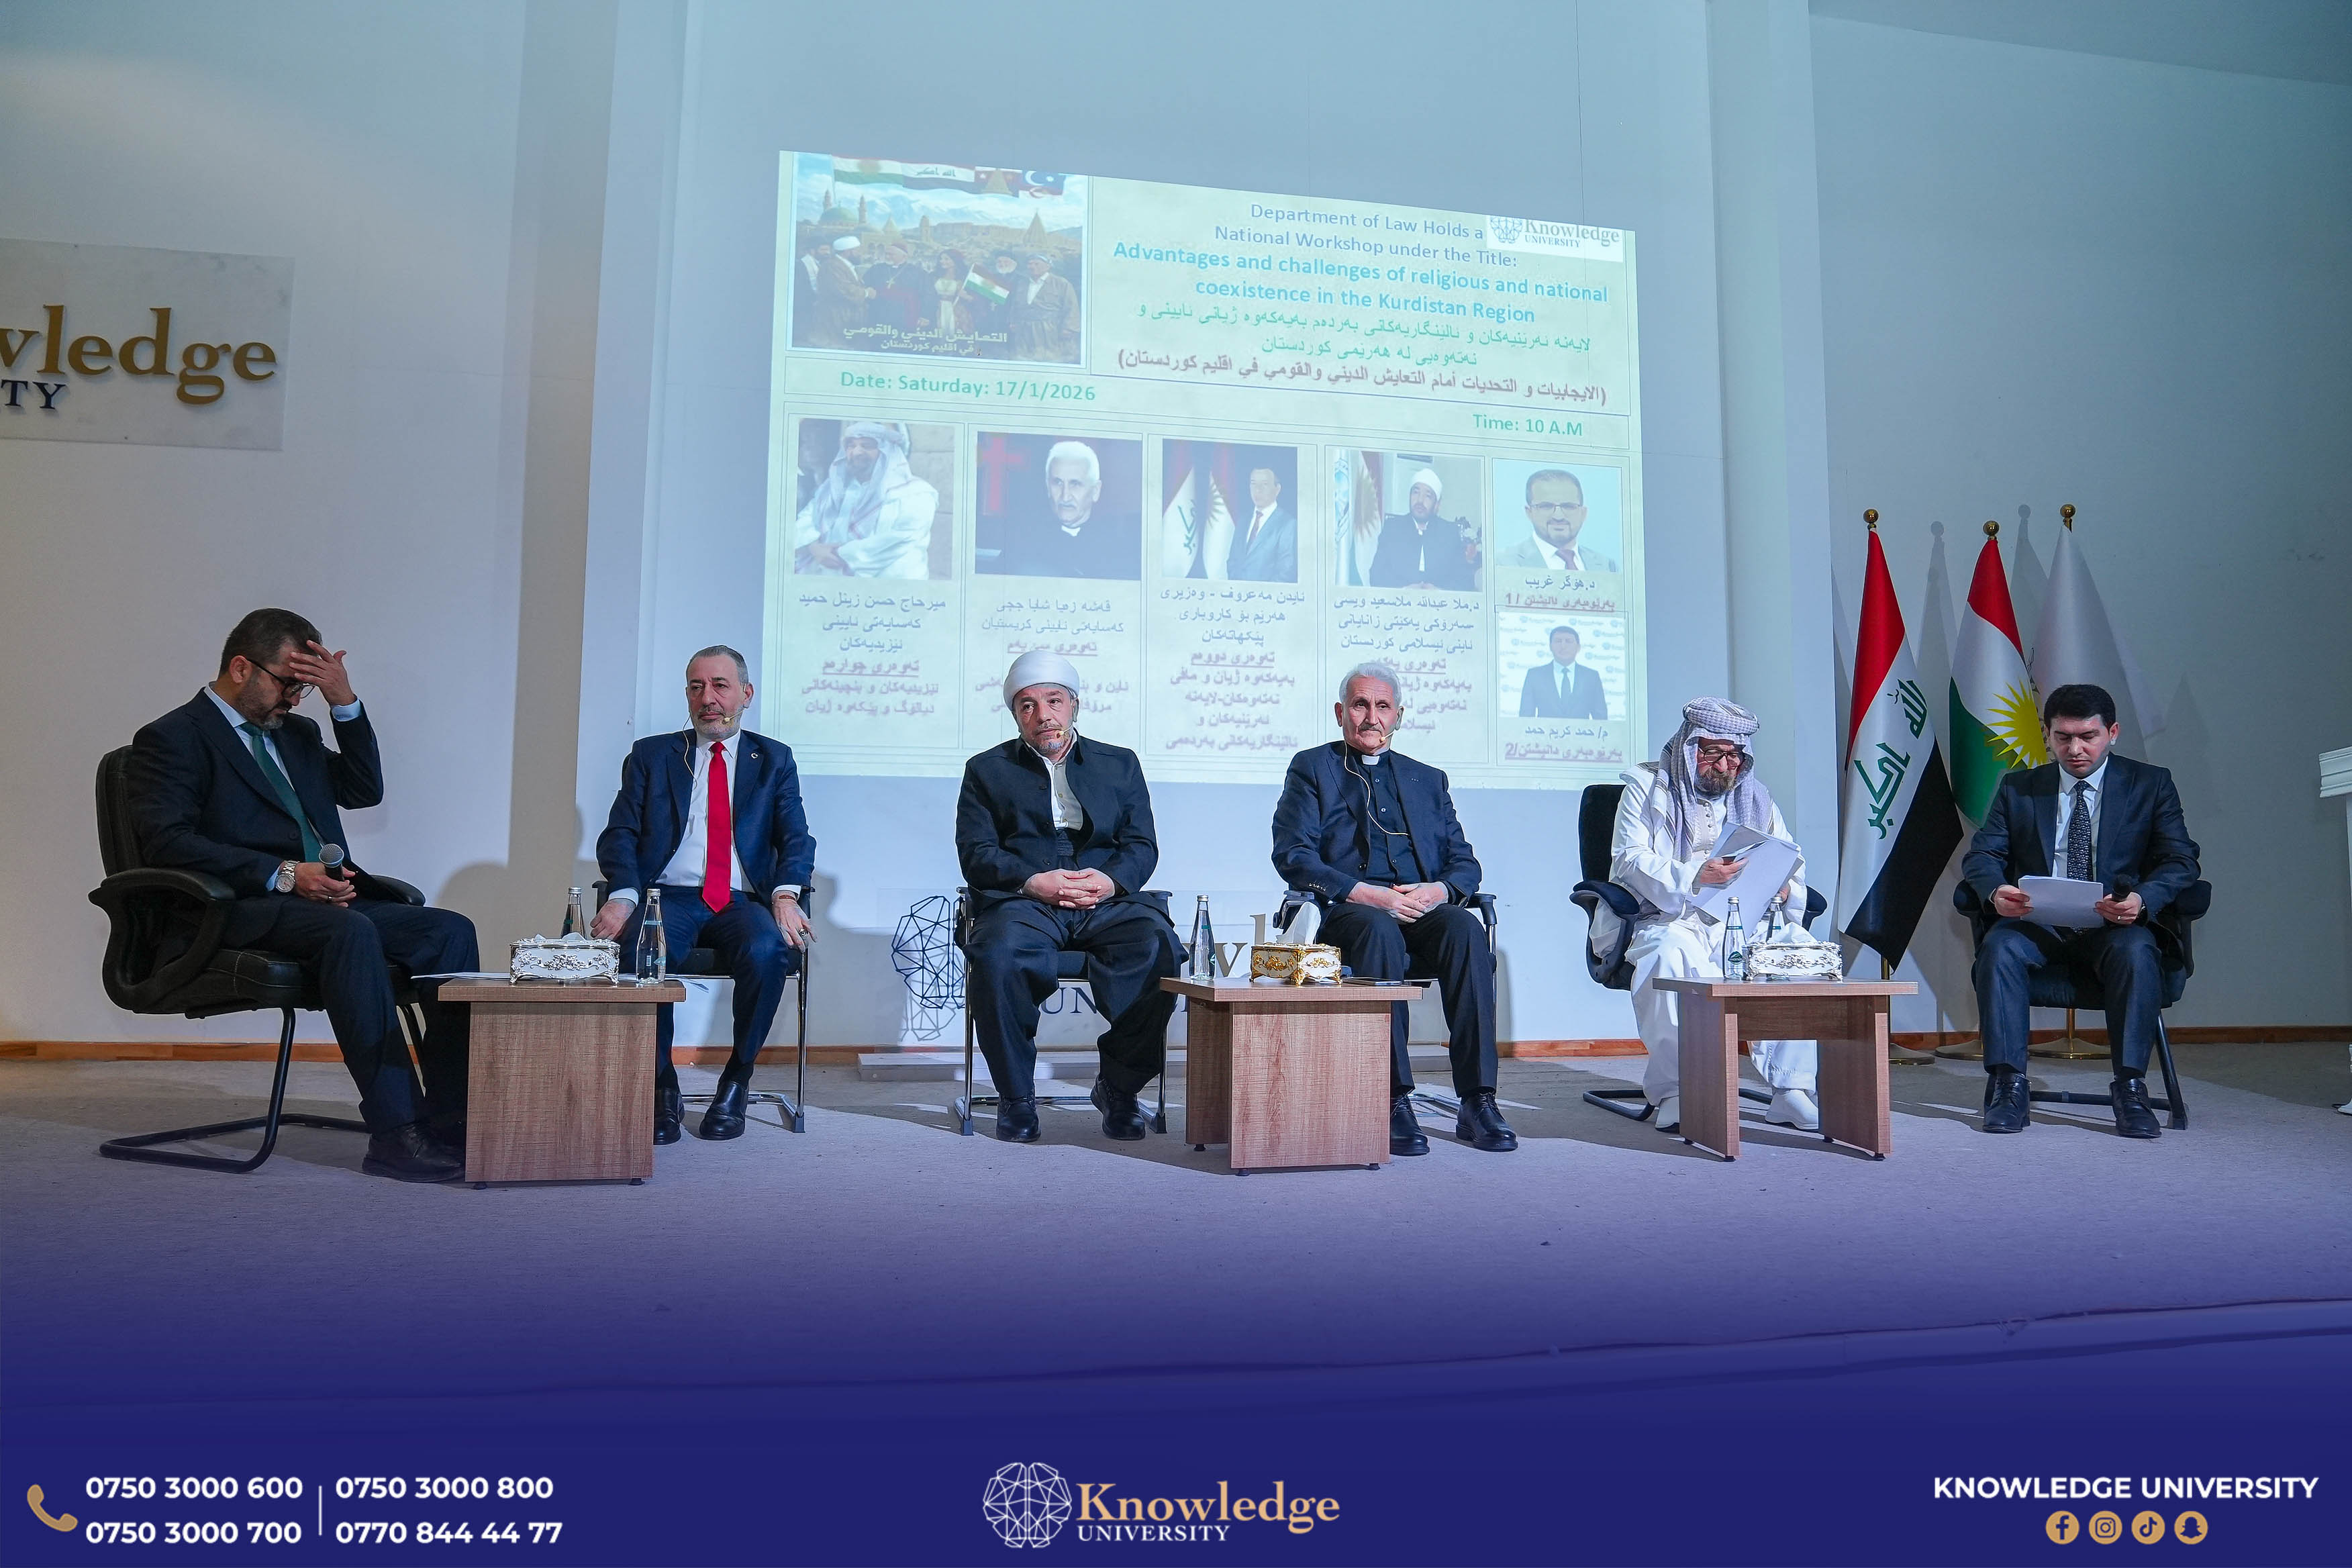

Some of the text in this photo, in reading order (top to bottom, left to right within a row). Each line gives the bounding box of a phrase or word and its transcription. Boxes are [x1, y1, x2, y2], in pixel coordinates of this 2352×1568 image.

[1251, 204, 1483, 239] Department of Law Holds a
[1525, 219, 1620, 247] Knowledge
[1525, 235, 1580, 248] UNIVERSITY
[1216, 226, 1517, 267] National Workshop under the Title:
[1114, 242, 1608, 302] Advantages and challenges of religious and national
[1137, 303, 1146, 316] و
[1196, 281, 1534, 323] coexistence in the Kurdistan Region
[901, 326, 943, 340] الديني
[945, 329, 1008, 344] التعايش
[1467, 332, 1474, 343] و
[1238, 356, 1259, 376] في
[1264, 361, 1322, 381] والقومي
[1328, 364, 1367, 385] الديني
[841, 371, 1096, 401] Date: Saturday: 17/1/2026
[1374, 368, 1425, 386] التعايش
[1462, 375, 1517, 394] التحديات
[1524, 384, 1534, 397] و
[1473, 414, 1583, 437] Time: 10 A.M
